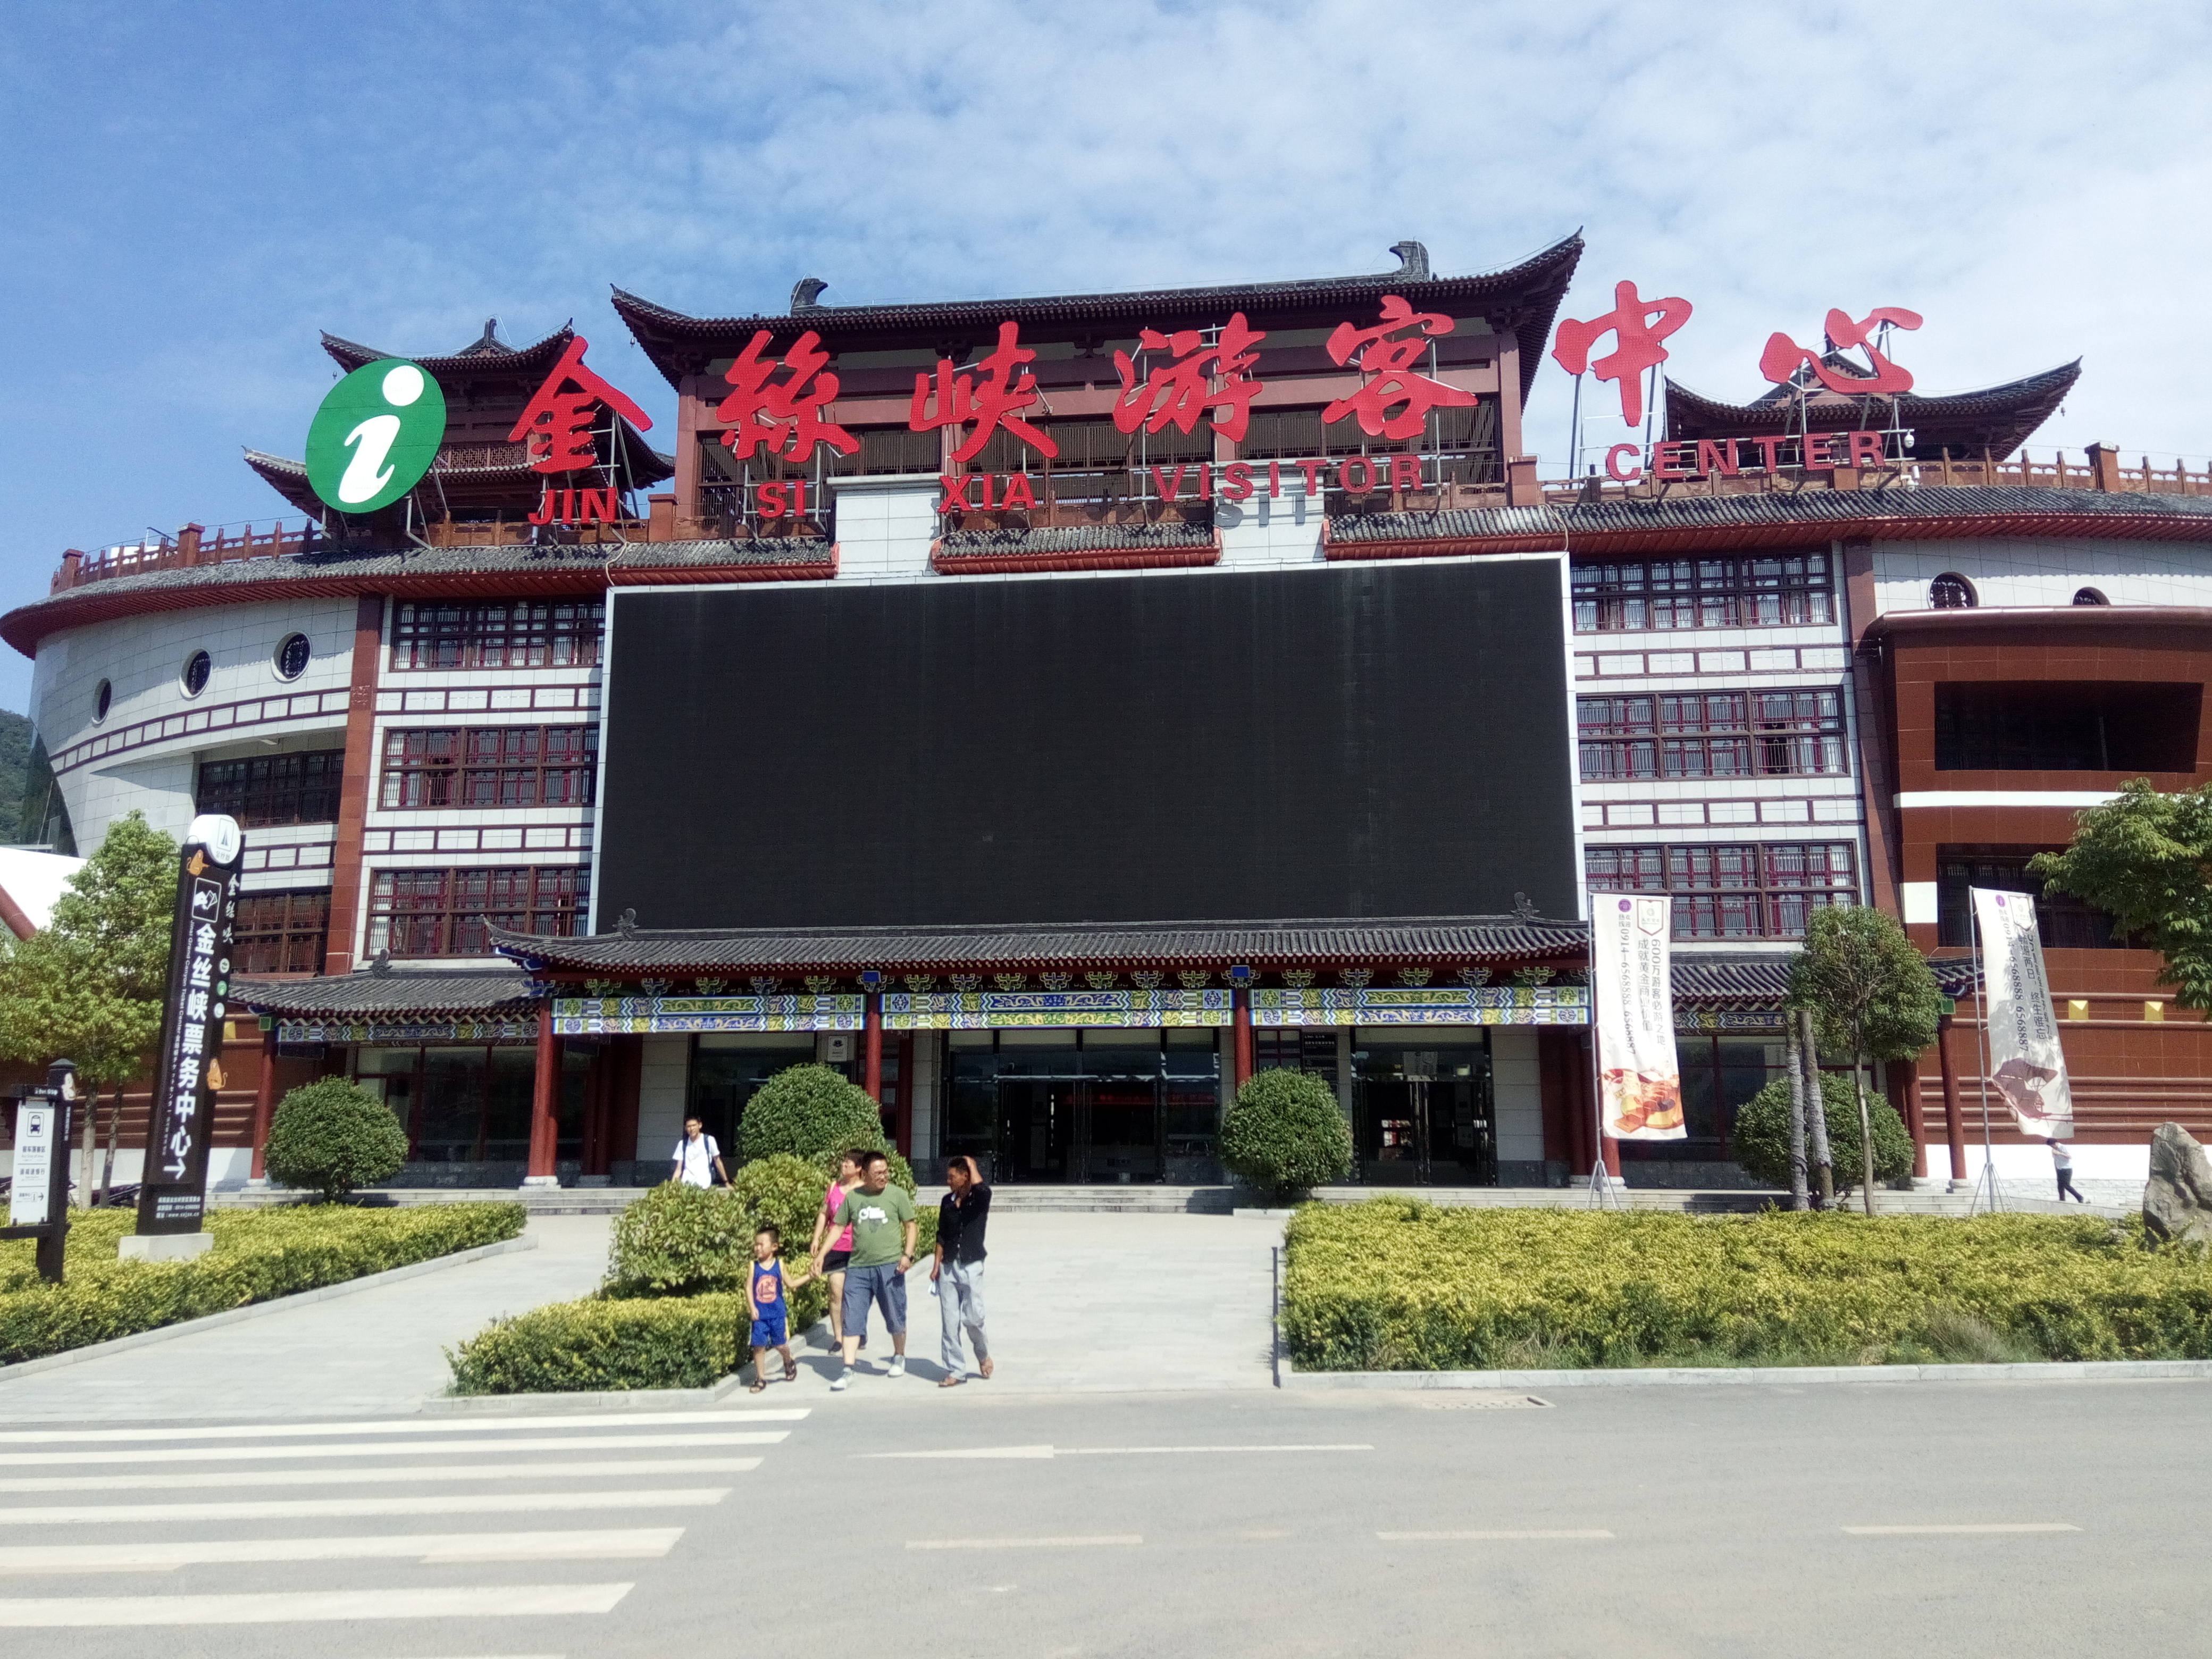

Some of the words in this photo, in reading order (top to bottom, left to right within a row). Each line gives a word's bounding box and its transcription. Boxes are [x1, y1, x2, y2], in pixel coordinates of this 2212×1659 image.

[527, 487, 618, 525] JIN
[756, 480, 807, 518] SI
[938, 472, 1038, 513] XIA
[1150, 455, 1423, 502] VISITOR
[1606, 431, 1885, 481] CENTER
[170, 923, 216, 1157] 金丝峡票务中心
